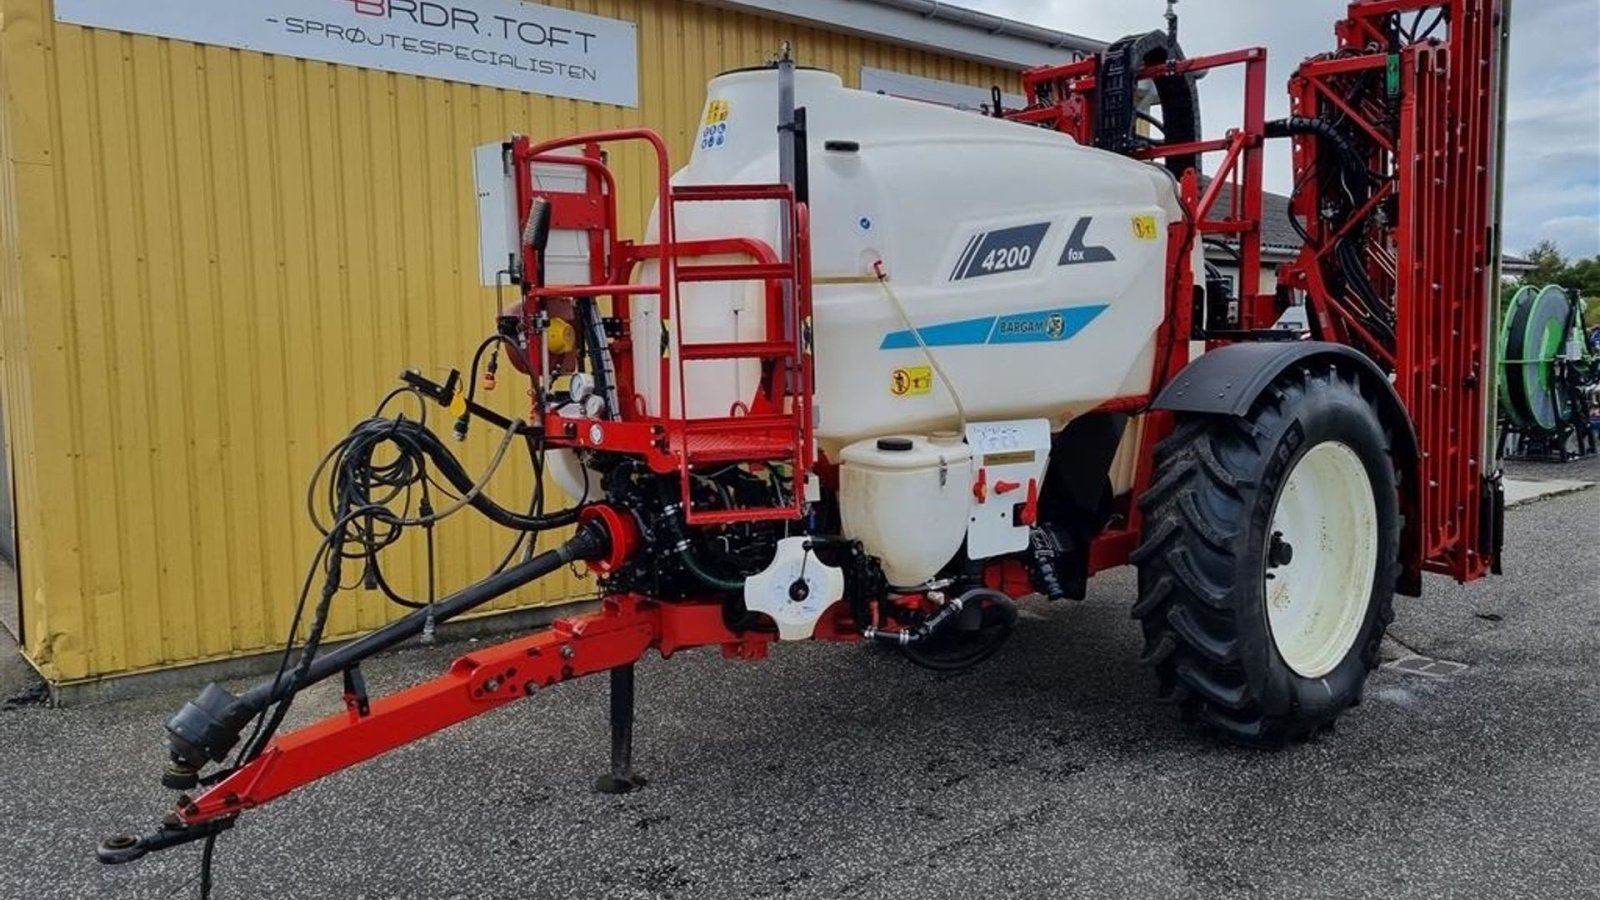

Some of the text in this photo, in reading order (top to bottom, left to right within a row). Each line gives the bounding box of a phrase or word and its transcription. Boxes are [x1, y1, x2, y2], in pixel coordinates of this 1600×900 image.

[981, 245, 1031, 270] 4200
[1068, 248, 1084, 260] fox
[1000, 319, 1043, 334] BARGAM
